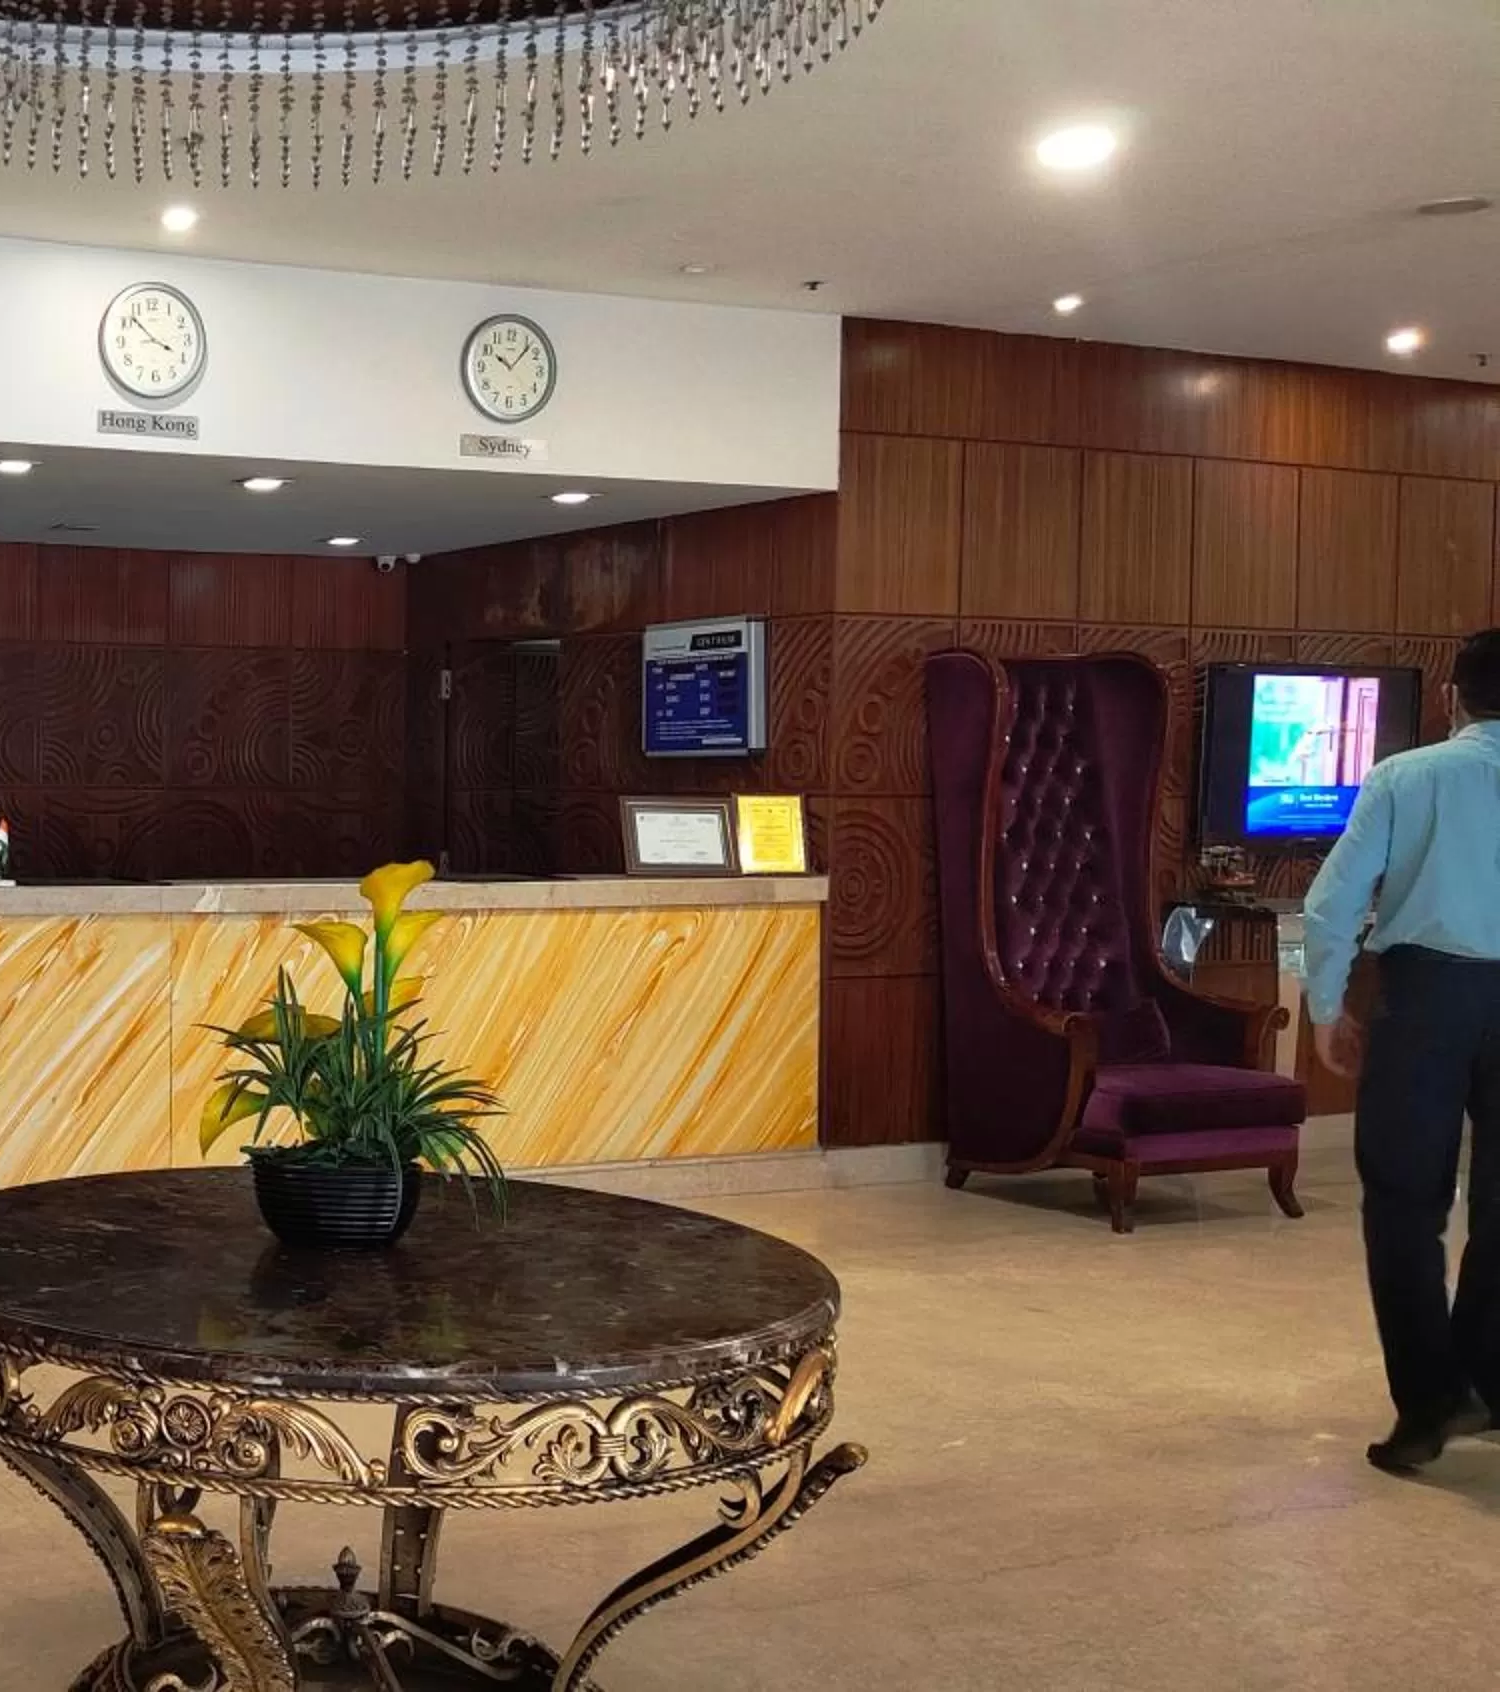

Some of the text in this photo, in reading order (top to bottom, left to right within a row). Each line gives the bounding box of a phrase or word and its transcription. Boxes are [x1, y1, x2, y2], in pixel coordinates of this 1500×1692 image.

[132, 303, 141, 316] 11
[147, 298, 158, 311] 12
[167, 303, 171, 316] 1
[177, 316, 185, 329] 2
[116, 336, 125, 348] 9
[184, 333, 192, 346] 3
[493, 332, 500, 344] 11
[507, 329, 516, 342] 12
[483, 344, 492, 356] 10
[532, 348, 540, 360] 2
[124, 354, 132, 366] 8
[478, 360, 485, 373] 9
[136, 366, 144, 380] 7
[151, 370, 161, 383] 6
[169, 366, 176, 379] 5
[536, 366, 543, 378] 3
[482, 379, 490, 390] 8
[531, 382, 536, 393] 4
[492, 392, 499, 403] 7
[505, 396, 513, 408] 6
[520, 394, 527, 406] 5
[102, 412, 196, 436] Hong Kong
[479, 438, 531, 458] Sydney
